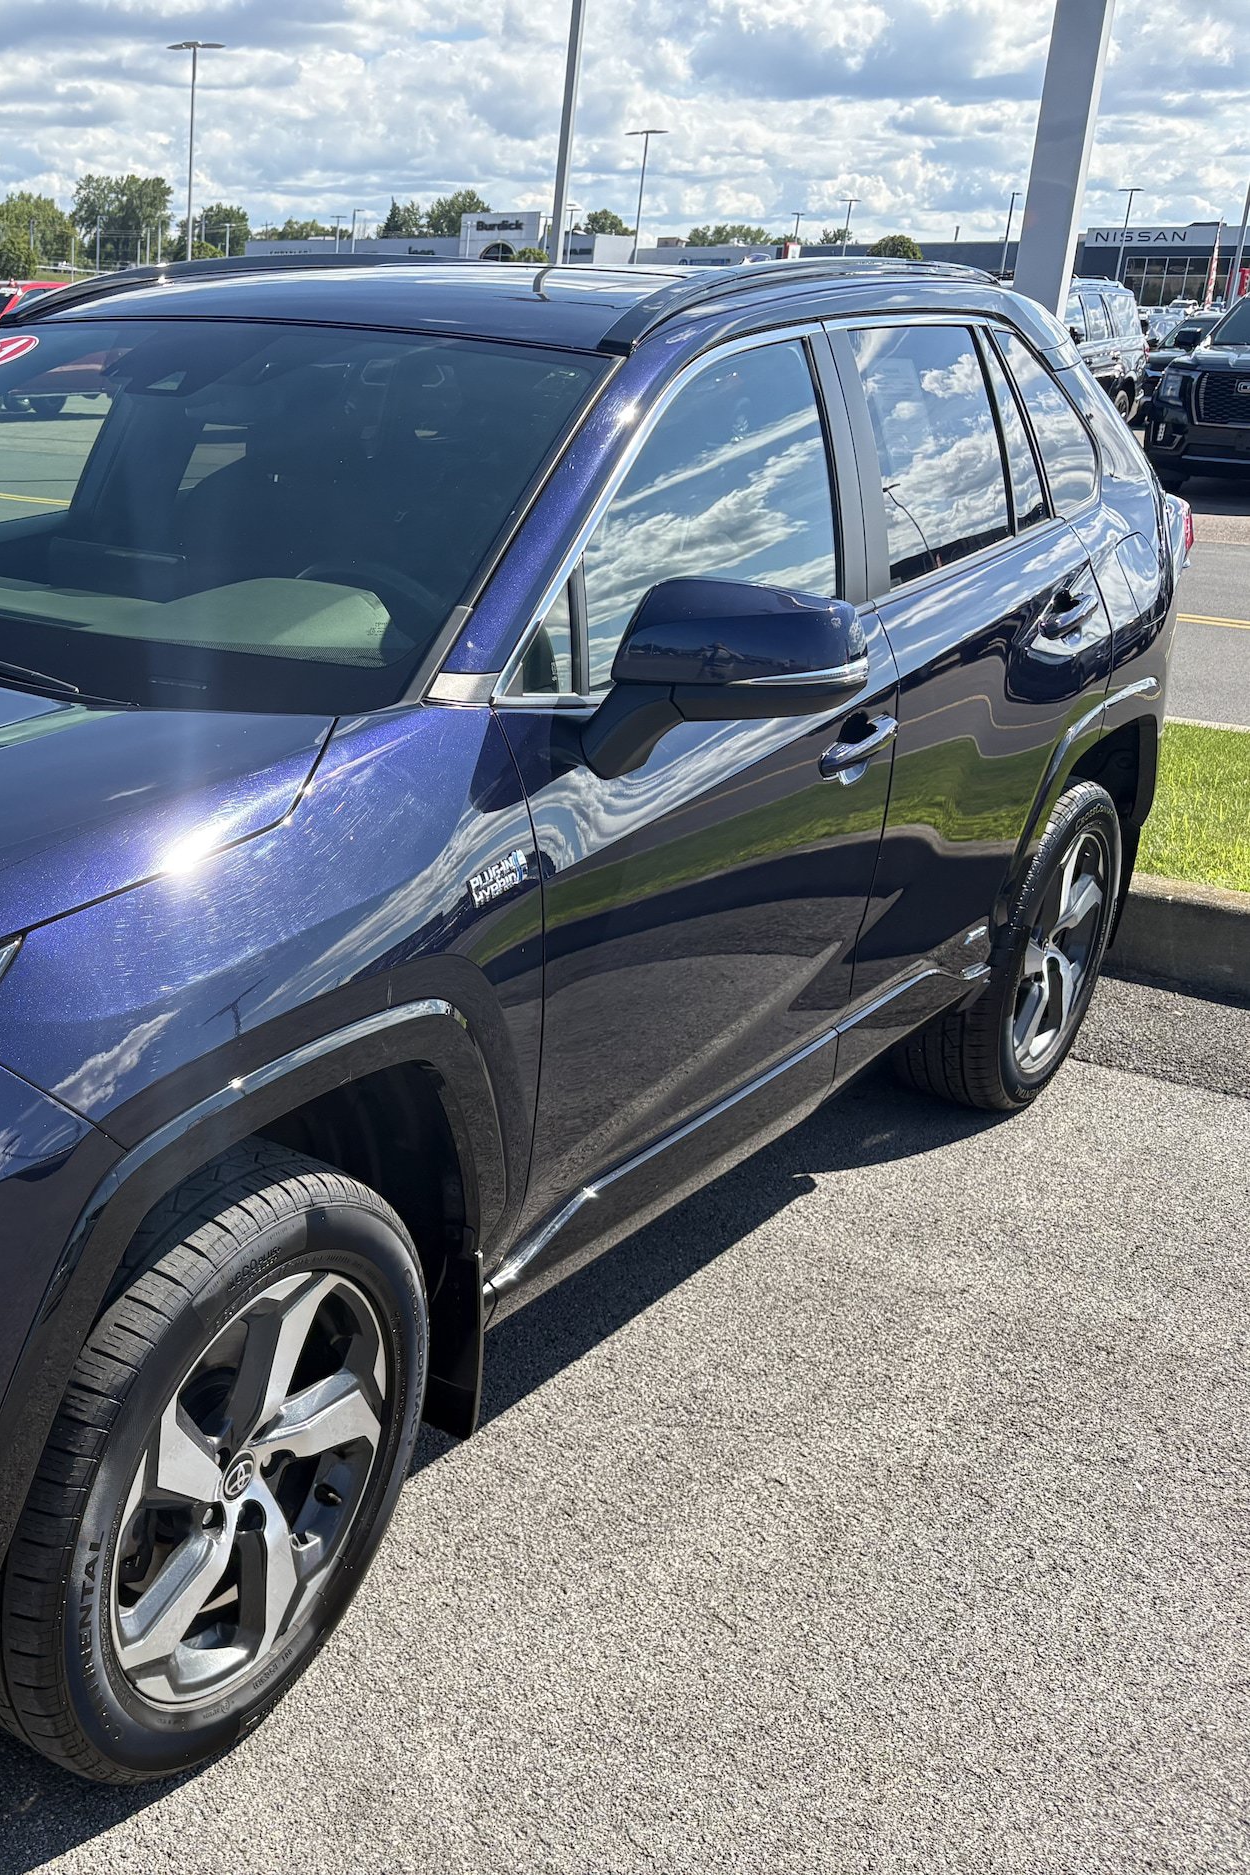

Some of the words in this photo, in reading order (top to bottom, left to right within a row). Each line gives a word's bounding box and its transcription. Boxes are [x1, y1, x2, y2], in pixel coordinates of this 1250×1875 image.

[476, 219, 524, 231] Burdick
[1094, 231, 1188, 243] NISSAN
[469, 856, 517, 891] PLUG-IN
